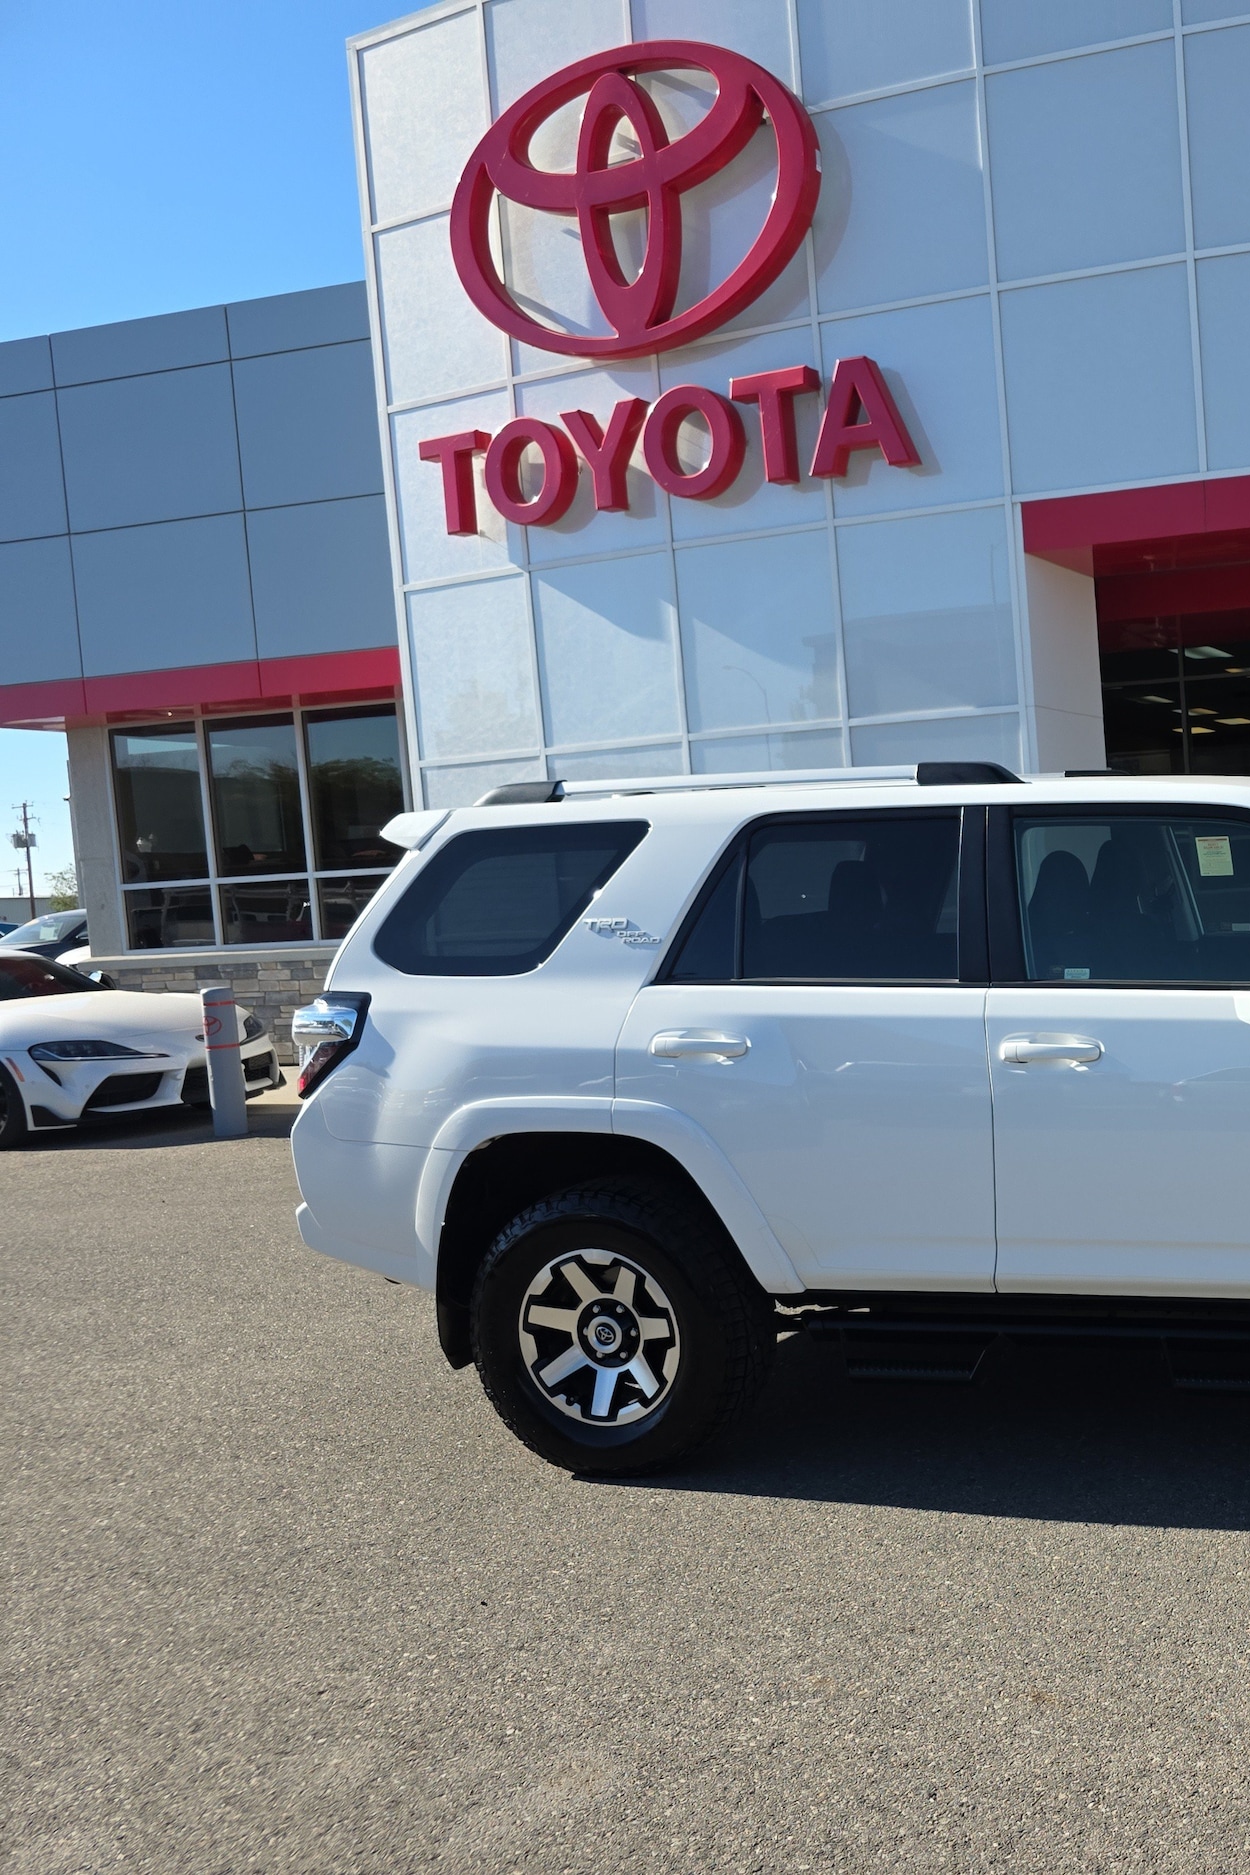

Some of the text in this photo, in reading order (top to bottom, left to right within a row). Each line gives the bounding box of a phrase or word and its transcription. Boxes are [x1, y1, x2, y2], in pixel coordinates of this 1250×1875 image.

[418, 355, 923, 537] TOYOTA
[583, 917, 628, 933] TRD
[616, 930, 647, 938] OFF
[621, 936, 662, 945] ROAD
